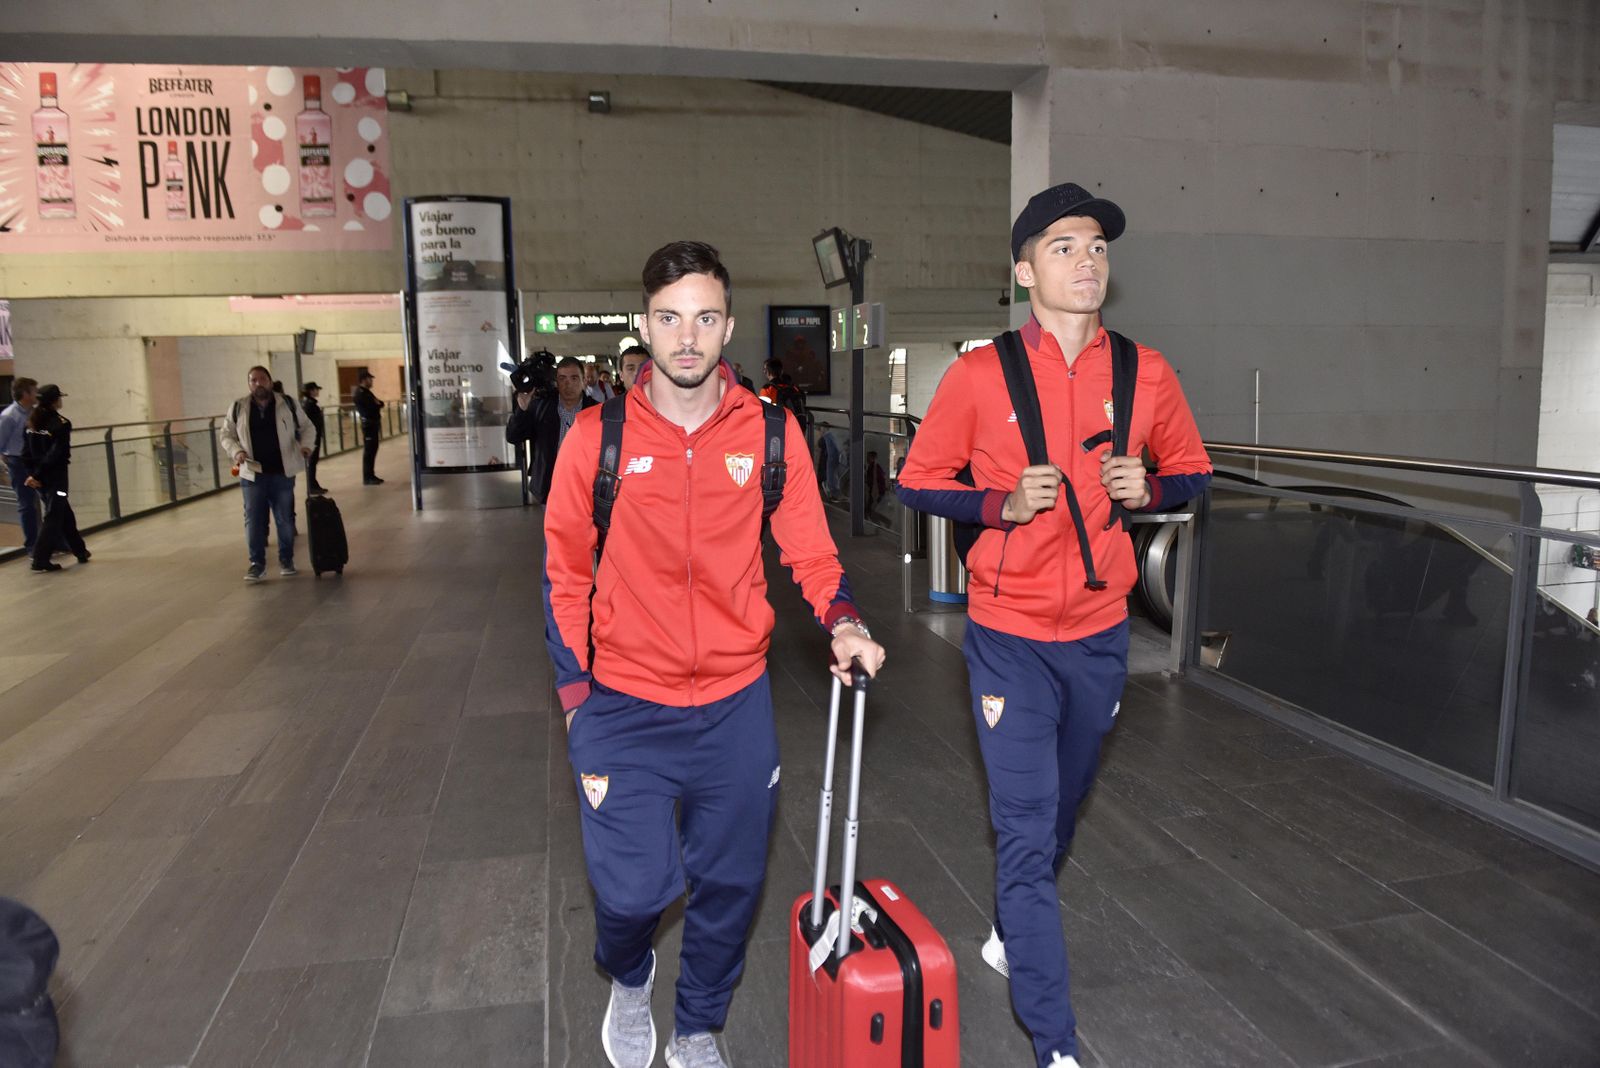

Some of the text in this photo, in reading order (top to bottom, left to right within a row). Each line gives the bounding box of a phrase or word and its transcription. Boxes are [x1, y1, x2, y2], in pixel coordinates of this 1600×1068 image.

[149, 78, 214, 96] BEEFEATER
[136, 106, 232, 137] LONDON
[419, 210, 454, 223] Viajar
[420, 223, 476, 236] es bueno
[105, 234, 138, 242] Disfruta
[140, 234, 150, 242] de
[421, 238, 462, 252] para la
[422, 252, 454, 264] salud
[832, 330, 837, 350] 3
[863, 324, 869, 345] 2
[427, 349, 461, 362] Viajar
[428, 362, 483, 374] es bueno
[429, 378, 455, 390] para
[429, 389, 461, 401] salud
